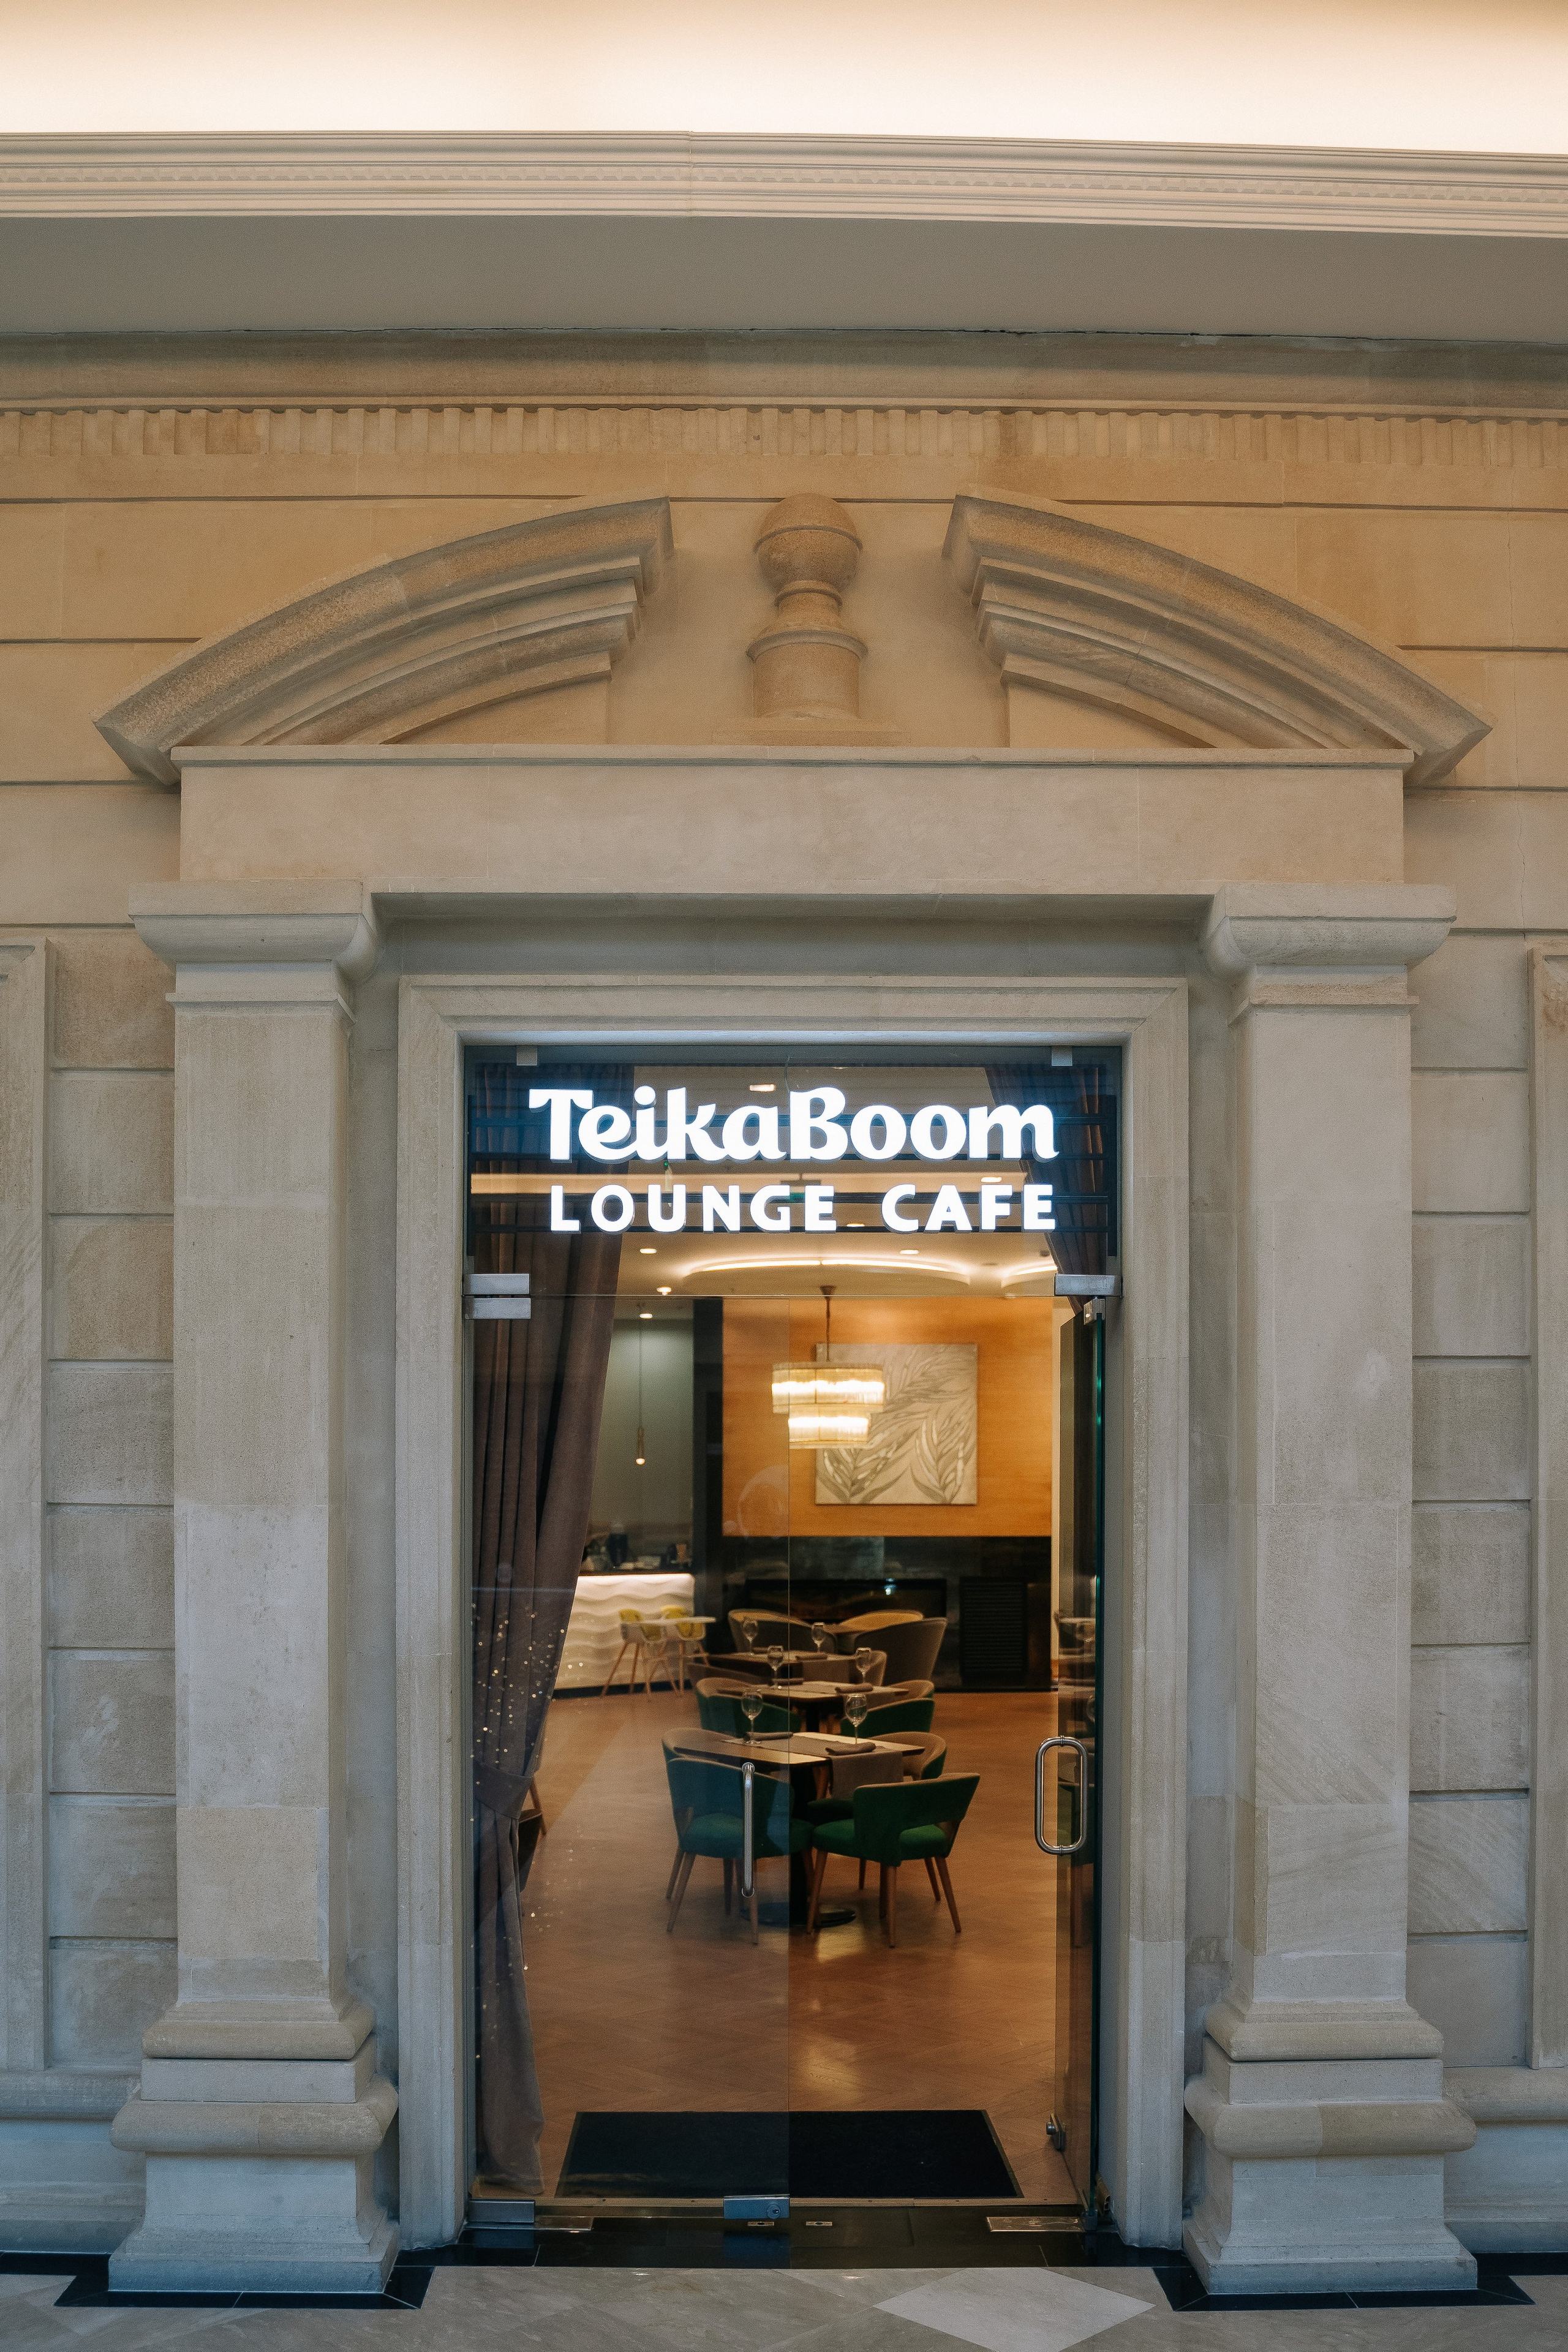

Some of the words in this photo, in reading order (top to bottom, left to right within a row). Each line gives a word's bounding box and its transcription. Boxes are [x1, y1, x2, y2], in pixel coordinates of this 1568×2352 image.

[529, 1085, 1059, 1163] TeikaBoom
[550, 1183, 837, 1233] LOUNGE
[881, 1183, 1056, 1232] CAFE
